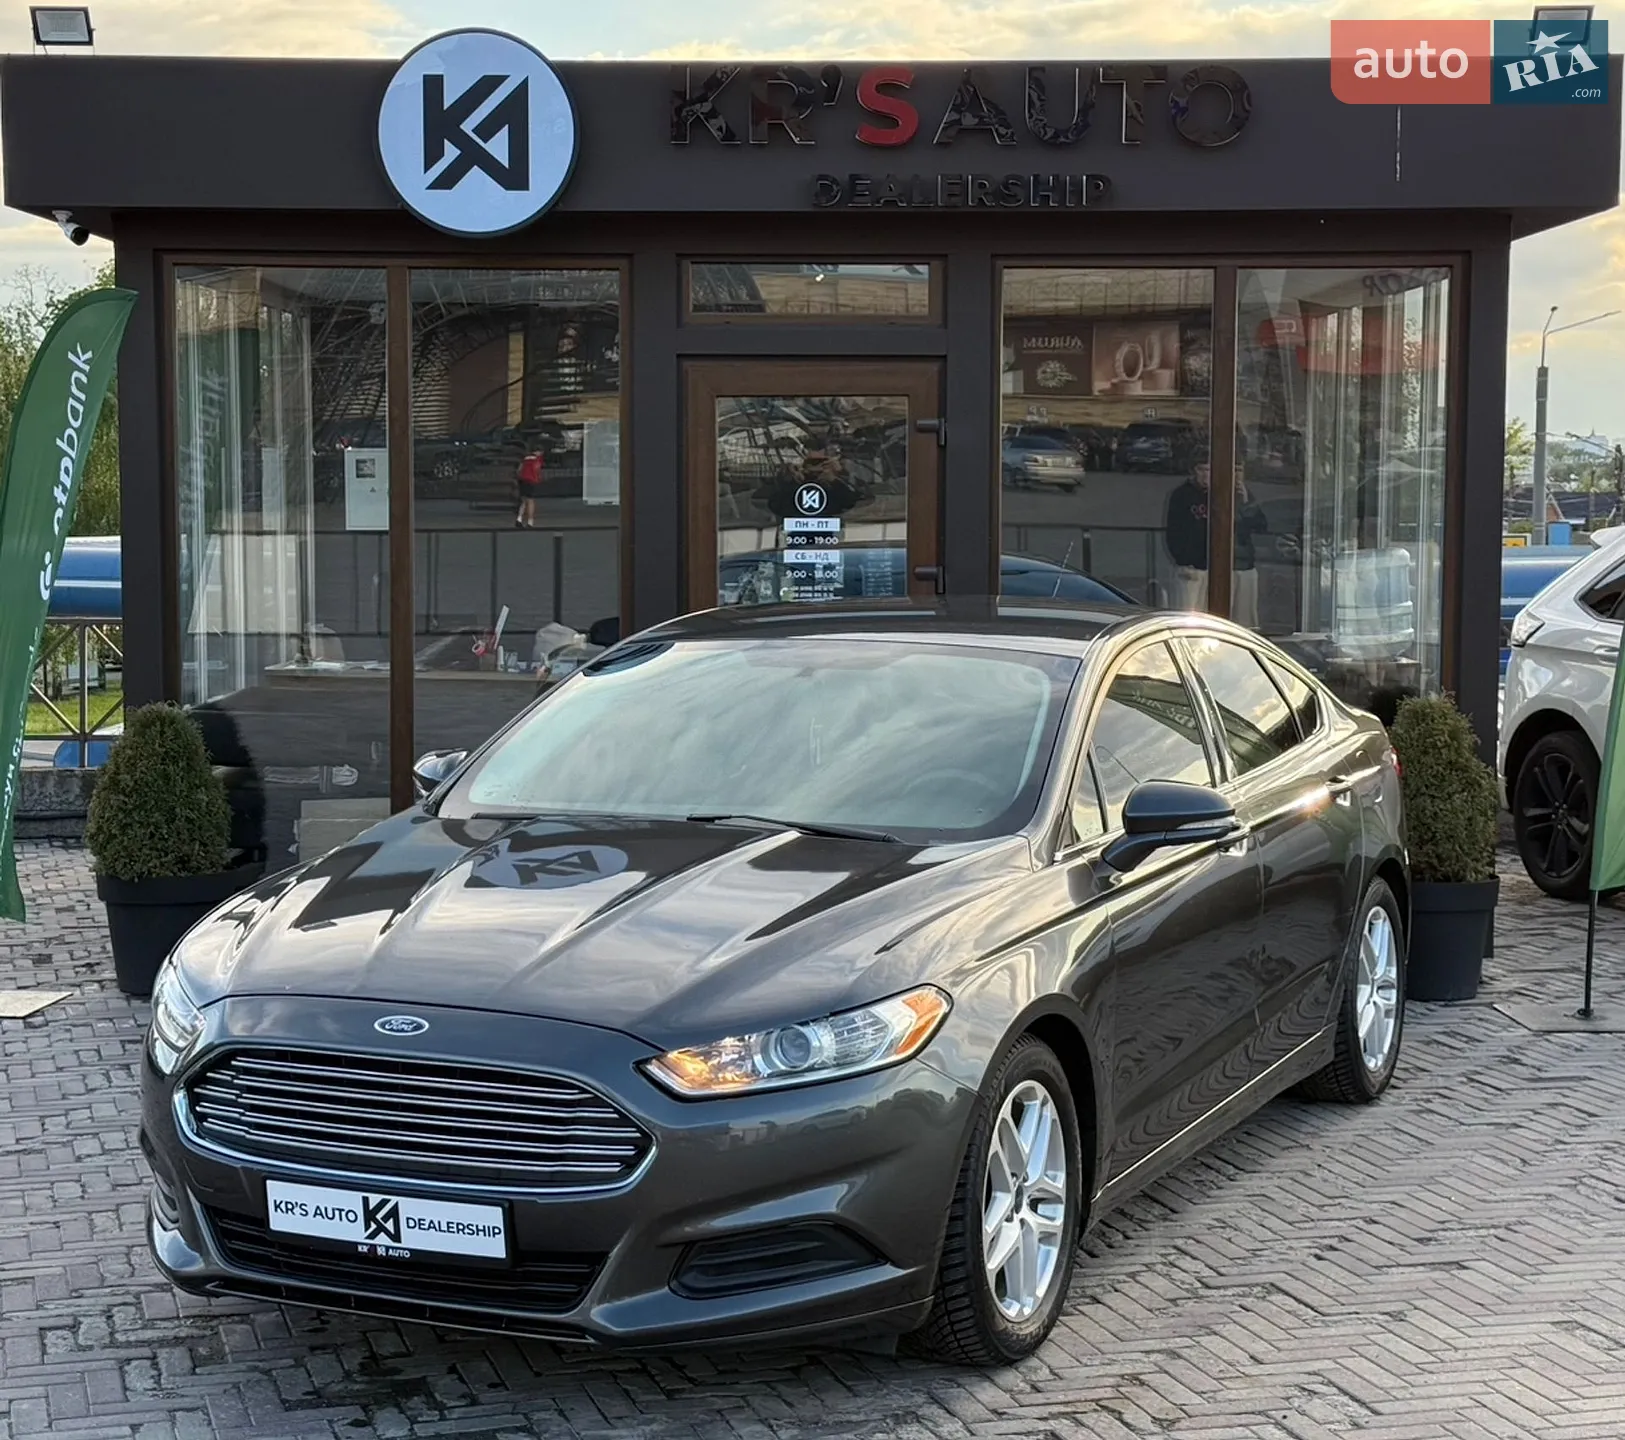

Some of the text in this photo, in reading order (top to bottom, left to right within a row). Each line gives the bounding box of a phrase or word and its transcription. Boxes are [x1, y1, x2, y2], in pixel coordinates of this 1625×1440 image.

[812, 173, 1114, 208] DEALERSHIP
[794, 521, 809, 529] ПН
[384, 1019, 417, 1031] Ford
[273, 1199, 309, 1218] KR'S
[312, 1205, 359, 1225] AUTO
[405, 1216, 502, 1239] DEALERSHIP
[387, 1248, 411, 1258] AUTO
